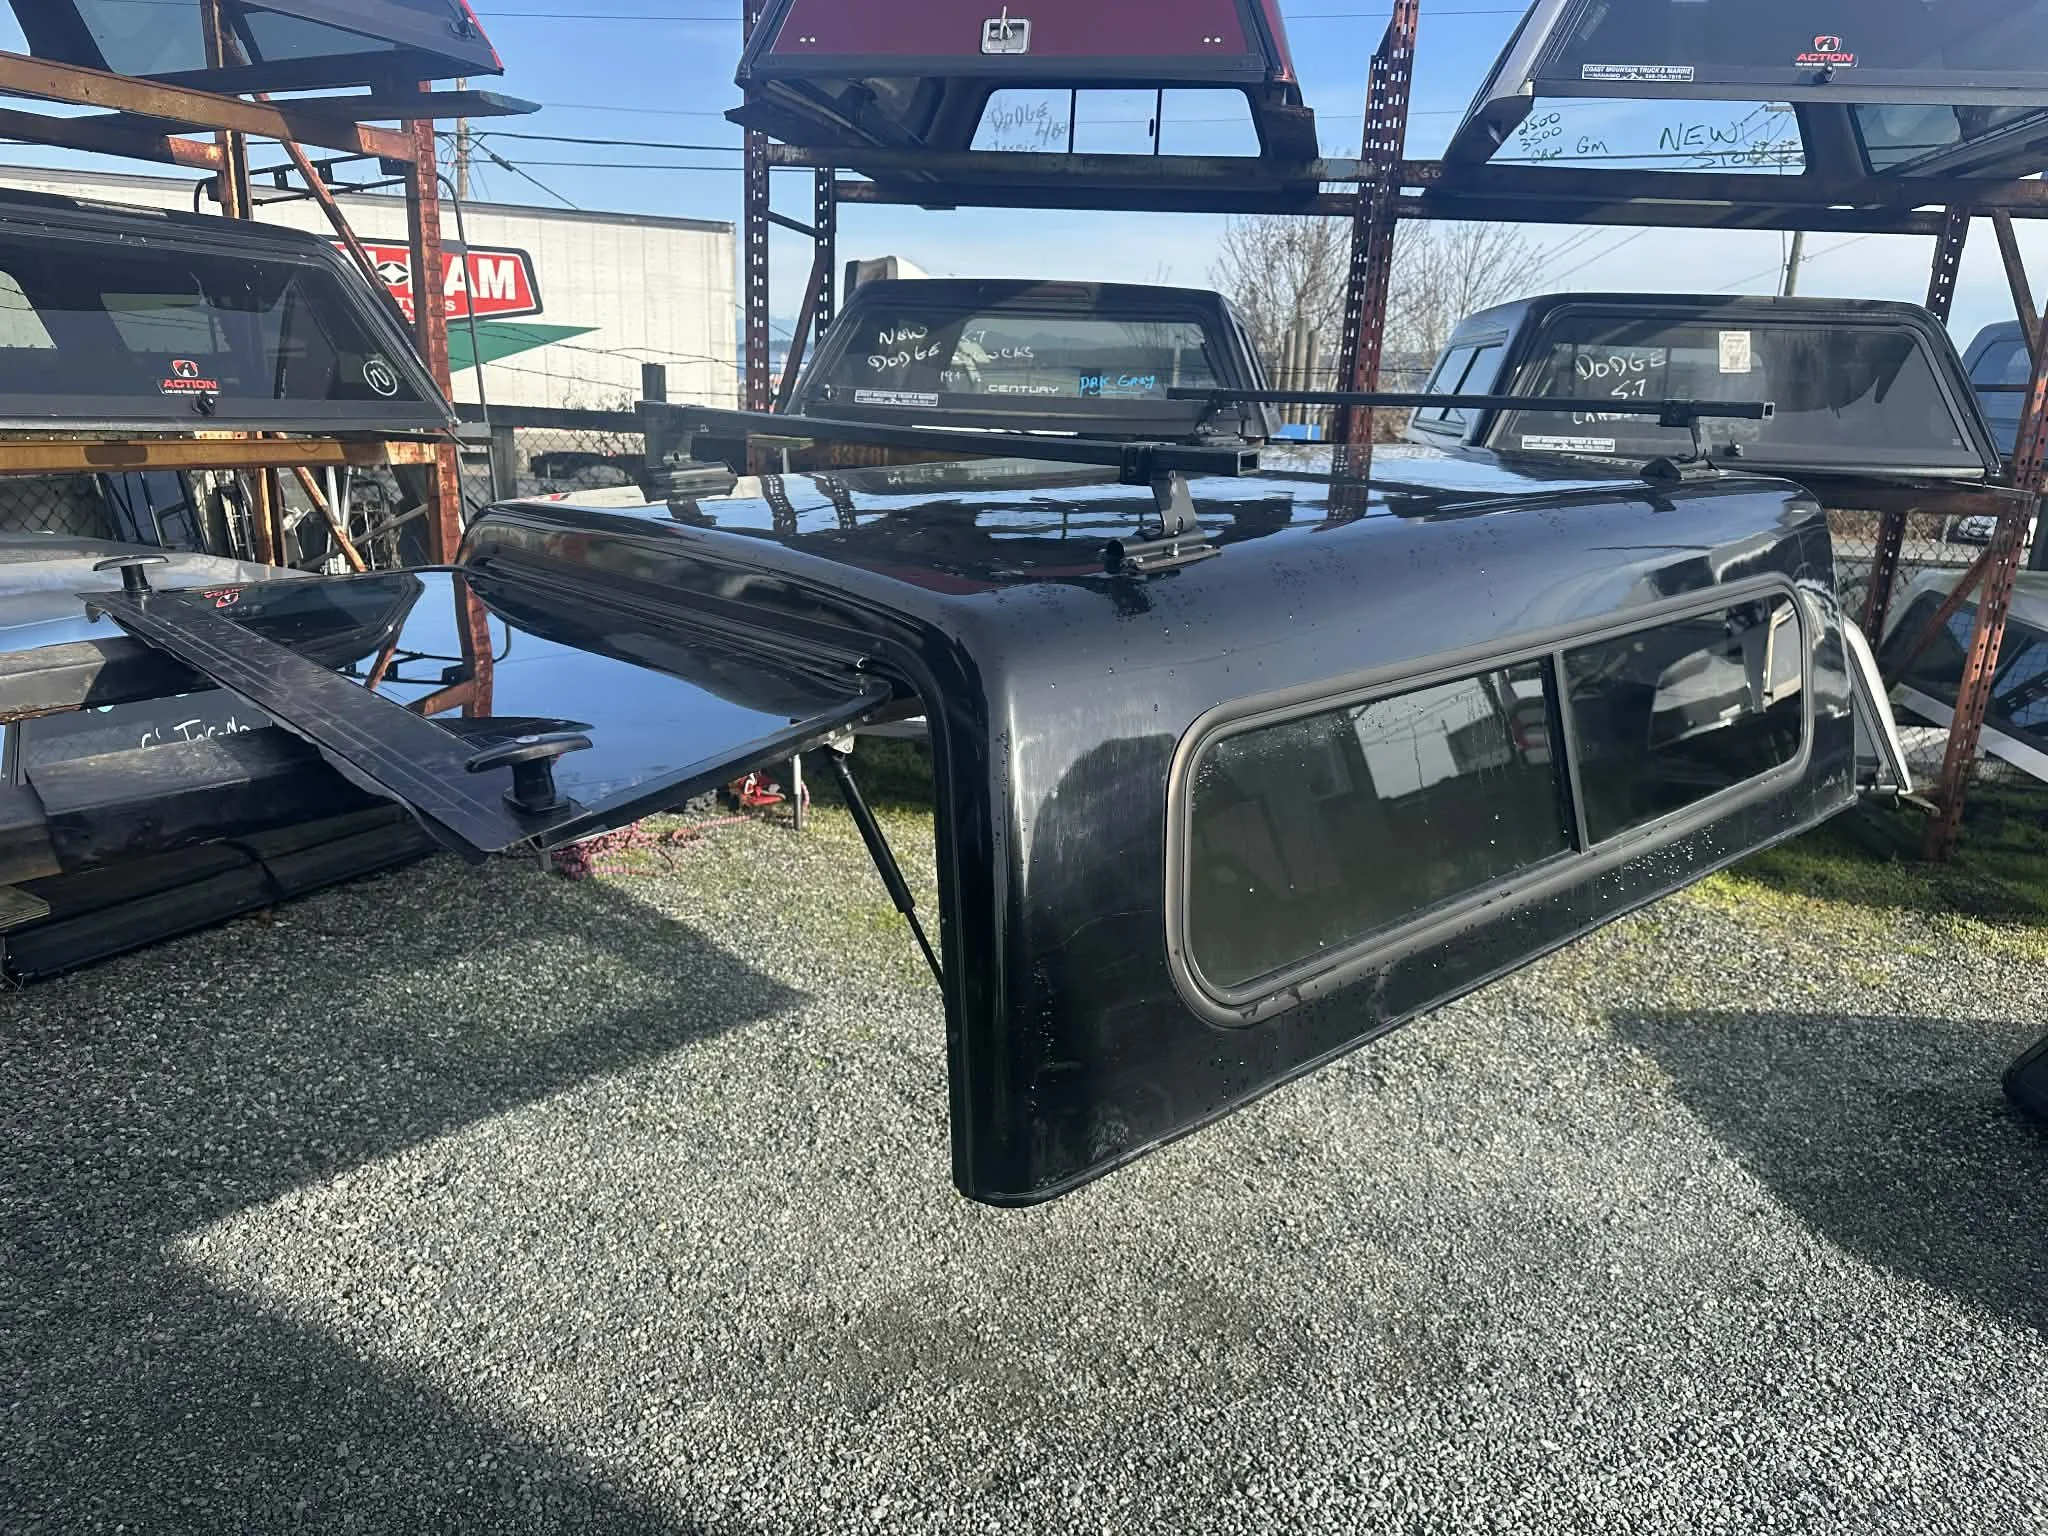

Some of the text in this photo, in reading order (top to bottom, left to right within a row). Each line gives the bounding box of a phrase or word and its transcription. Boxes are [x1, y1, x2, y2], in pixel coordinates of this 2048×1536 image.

[1796, 53, 1854, 62] ACTION
[1667, 67, 1691, 75] MARINE
[1518, 112, 1561, 136] 2500
[1520, 126, 1562, 152] 3500
[1659, 121, 1738, 151] NEW
[867, 341, 941, 372] DODGE
[1575, 348, 1667, 380] DODGE
[163, 379, 217, 389] ACTION
[988, 384, 1060, 394] CENTURY
[1611, 379, 1647, 400] 5.7
